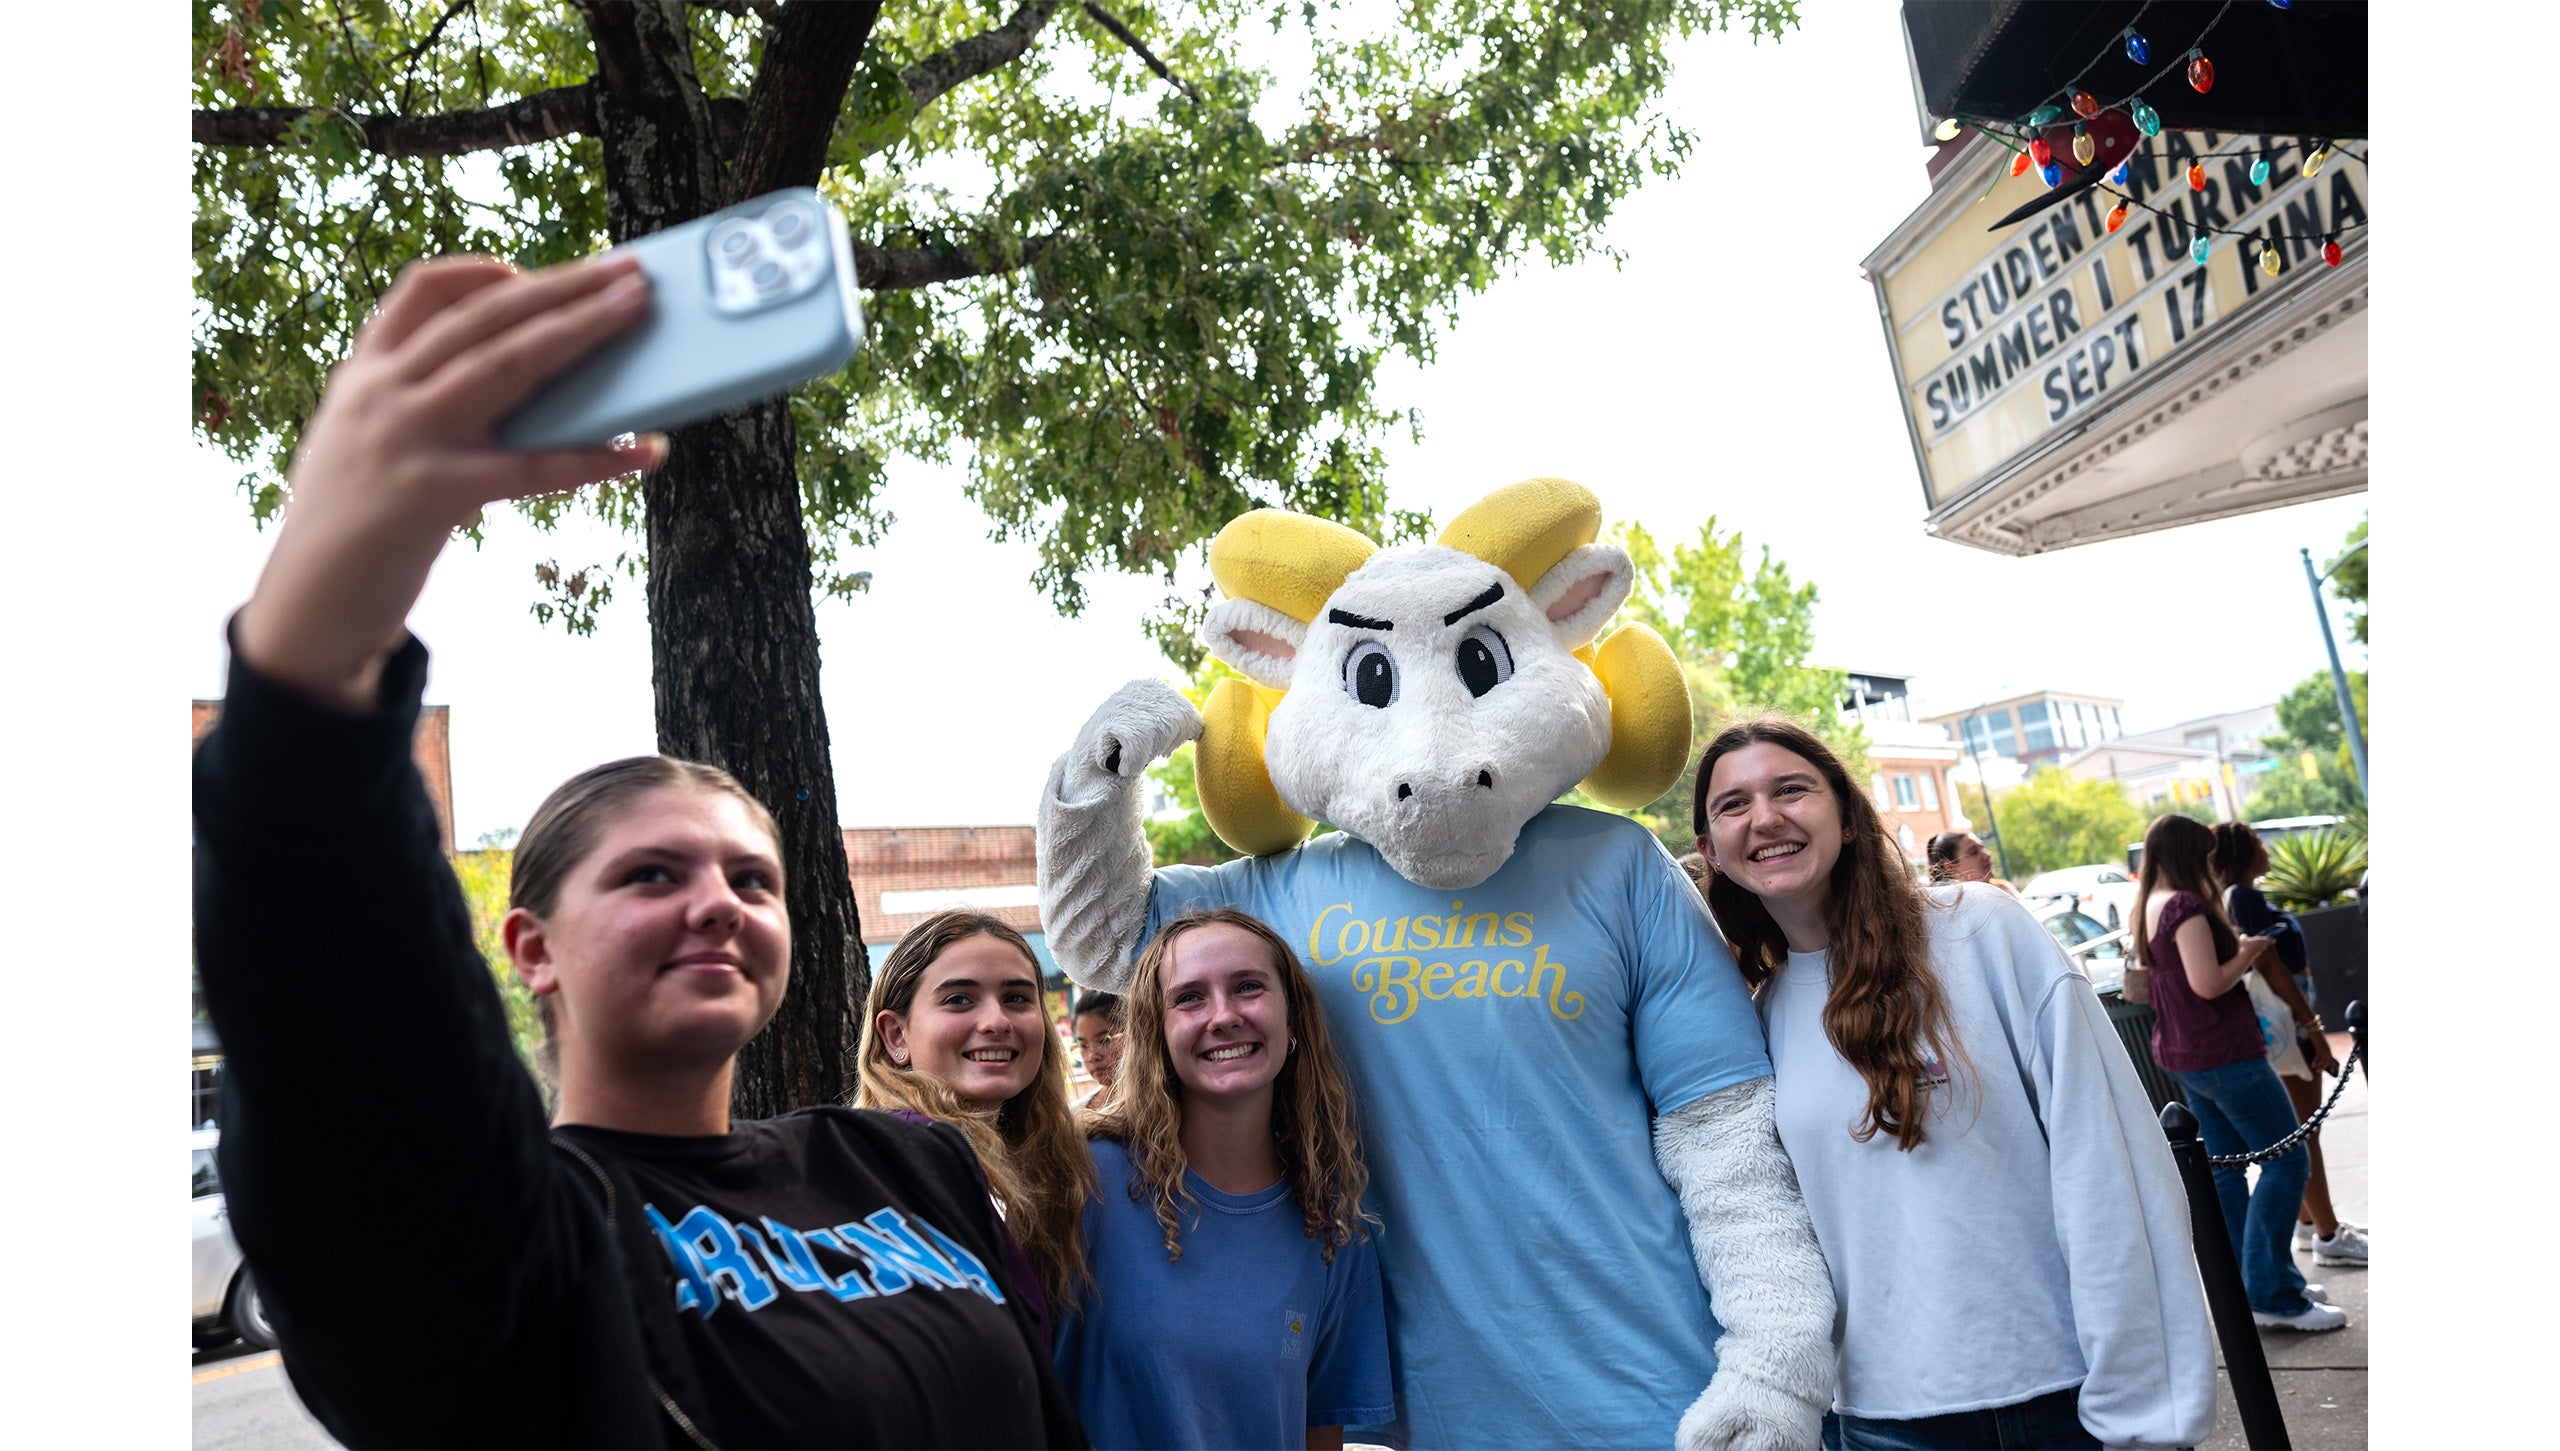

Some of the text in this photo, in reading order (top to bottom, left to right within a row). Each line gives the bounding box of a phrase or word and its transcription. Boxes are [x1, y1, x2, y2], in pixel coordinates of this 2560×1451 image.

[1926, 288, 2081, 429] SUMMER
[2093, 259, 2113, 313] I
[1942, 186, 2103, 349] STUDENT
[2044, 313, 2140, 421] SEPT
[2165, 266, 2207, 344] 17
[1309, 900, 1535, 967] Cousins
[1351, 943, 1585, 1025] Beach
